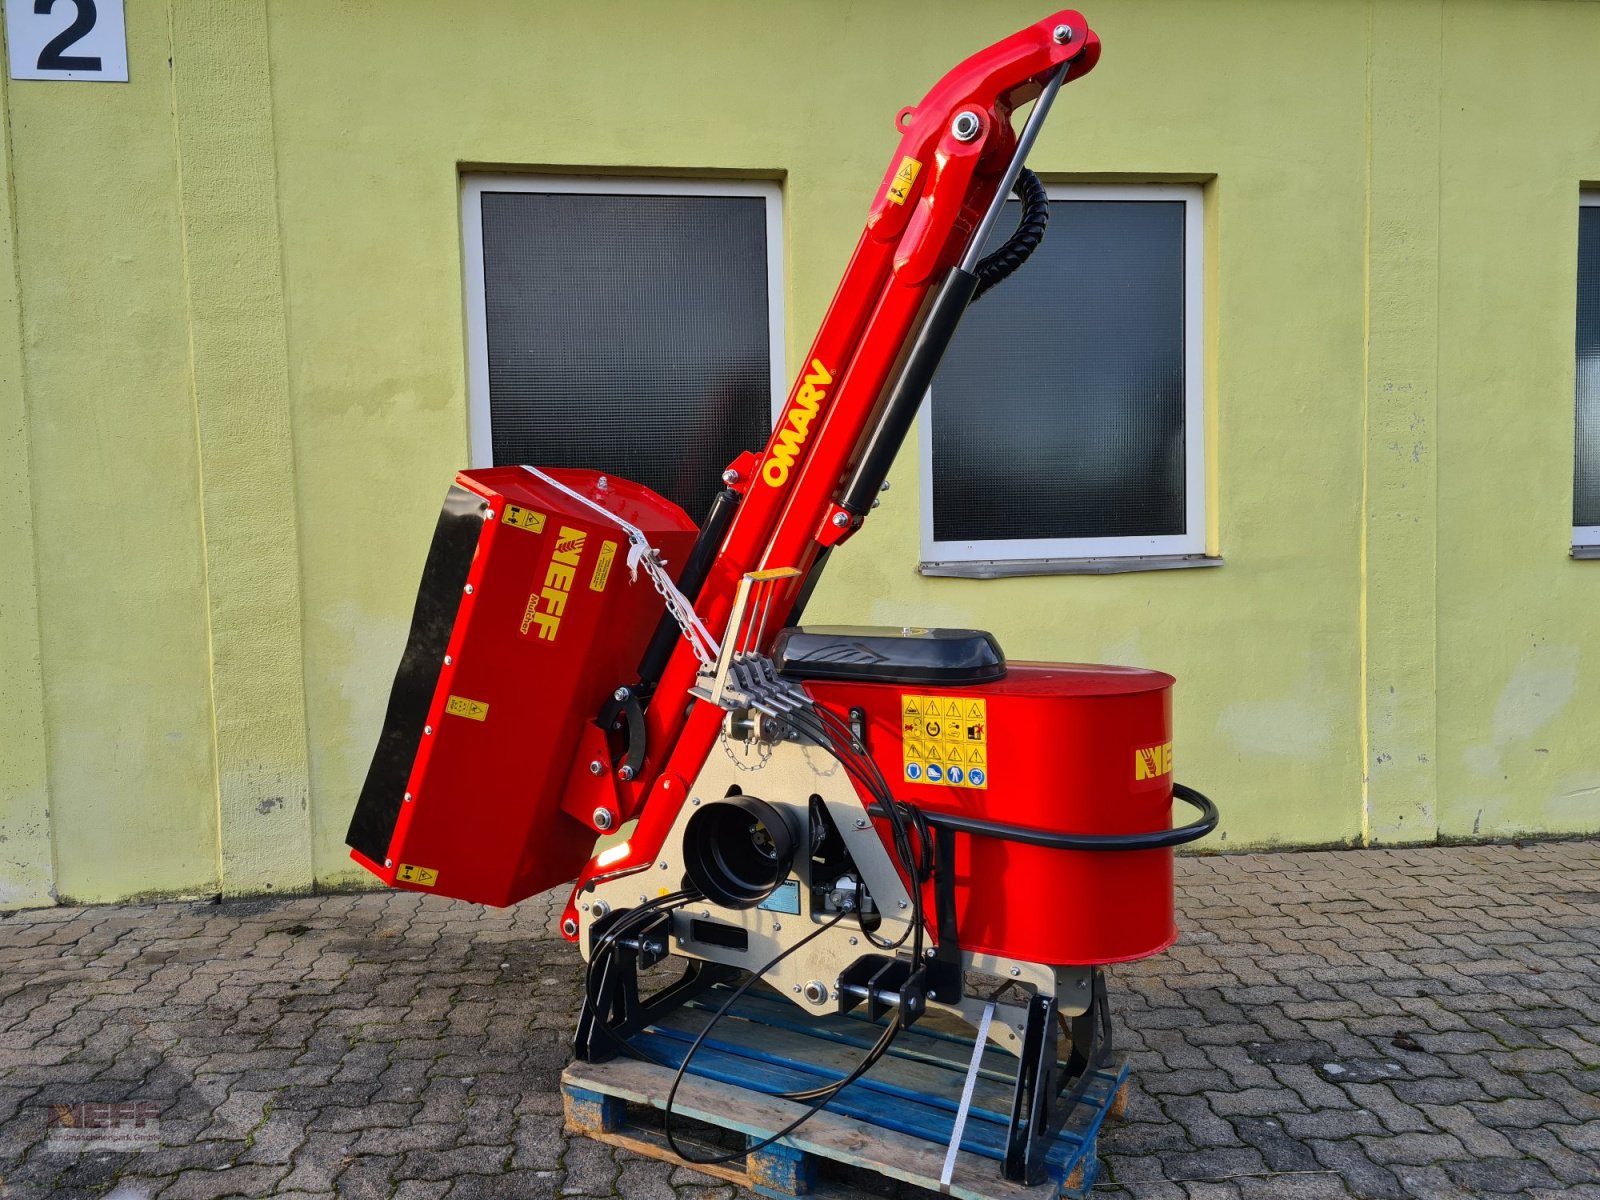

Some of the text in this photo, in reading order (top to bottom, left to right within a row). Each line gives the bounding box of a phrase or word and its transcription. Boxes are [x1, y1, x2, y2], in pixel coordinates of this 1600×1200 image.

[34, 0, 102, 71] 2
[762, 358, 833, 488] OMARV
[519, 593, 539, 635] Mulcher
[532, 525, 588, 642] NEFF
